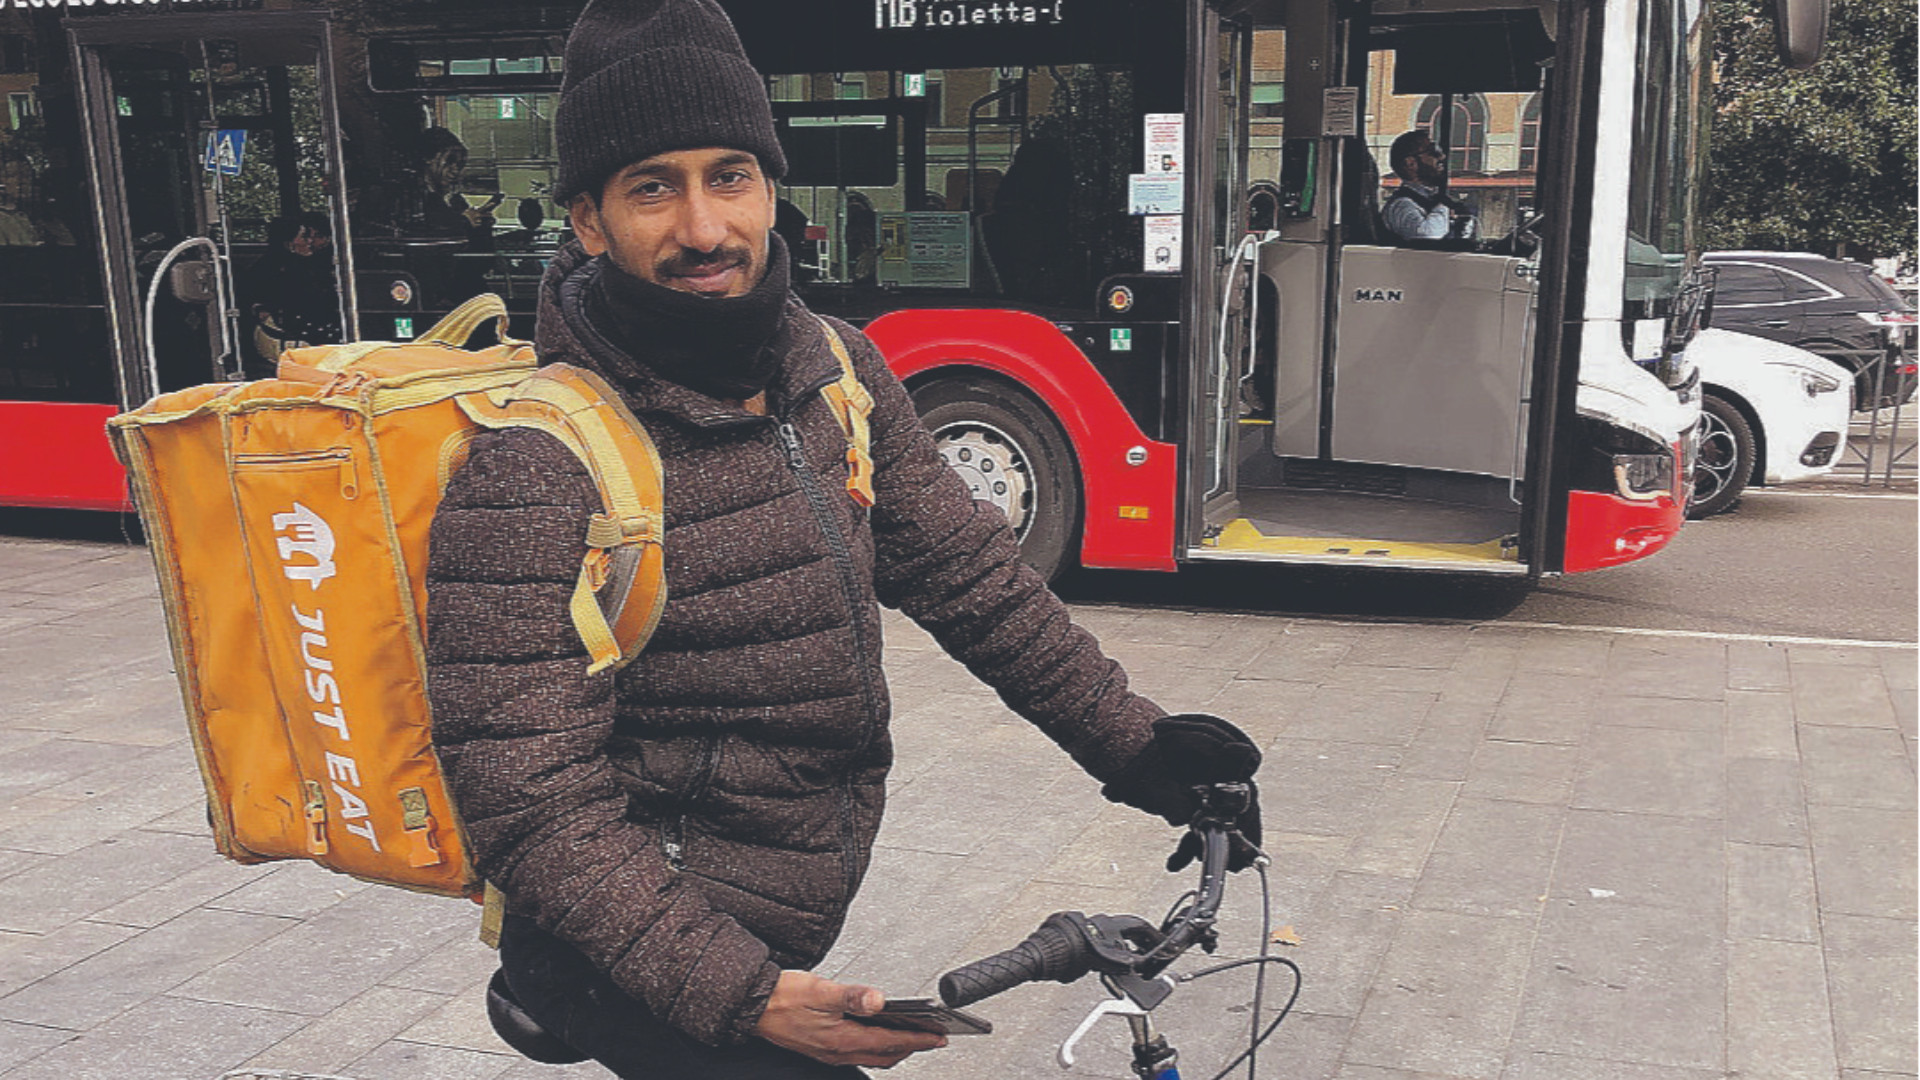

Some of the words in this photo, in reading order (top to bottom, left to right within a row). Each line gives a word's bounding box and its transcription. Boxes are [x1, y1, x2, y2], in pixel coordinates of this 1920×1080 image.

[1356, 289, 1402, 301] MAN
[291, 603, 350, 741] JUST
[325, 750, 382, 853] EAT
